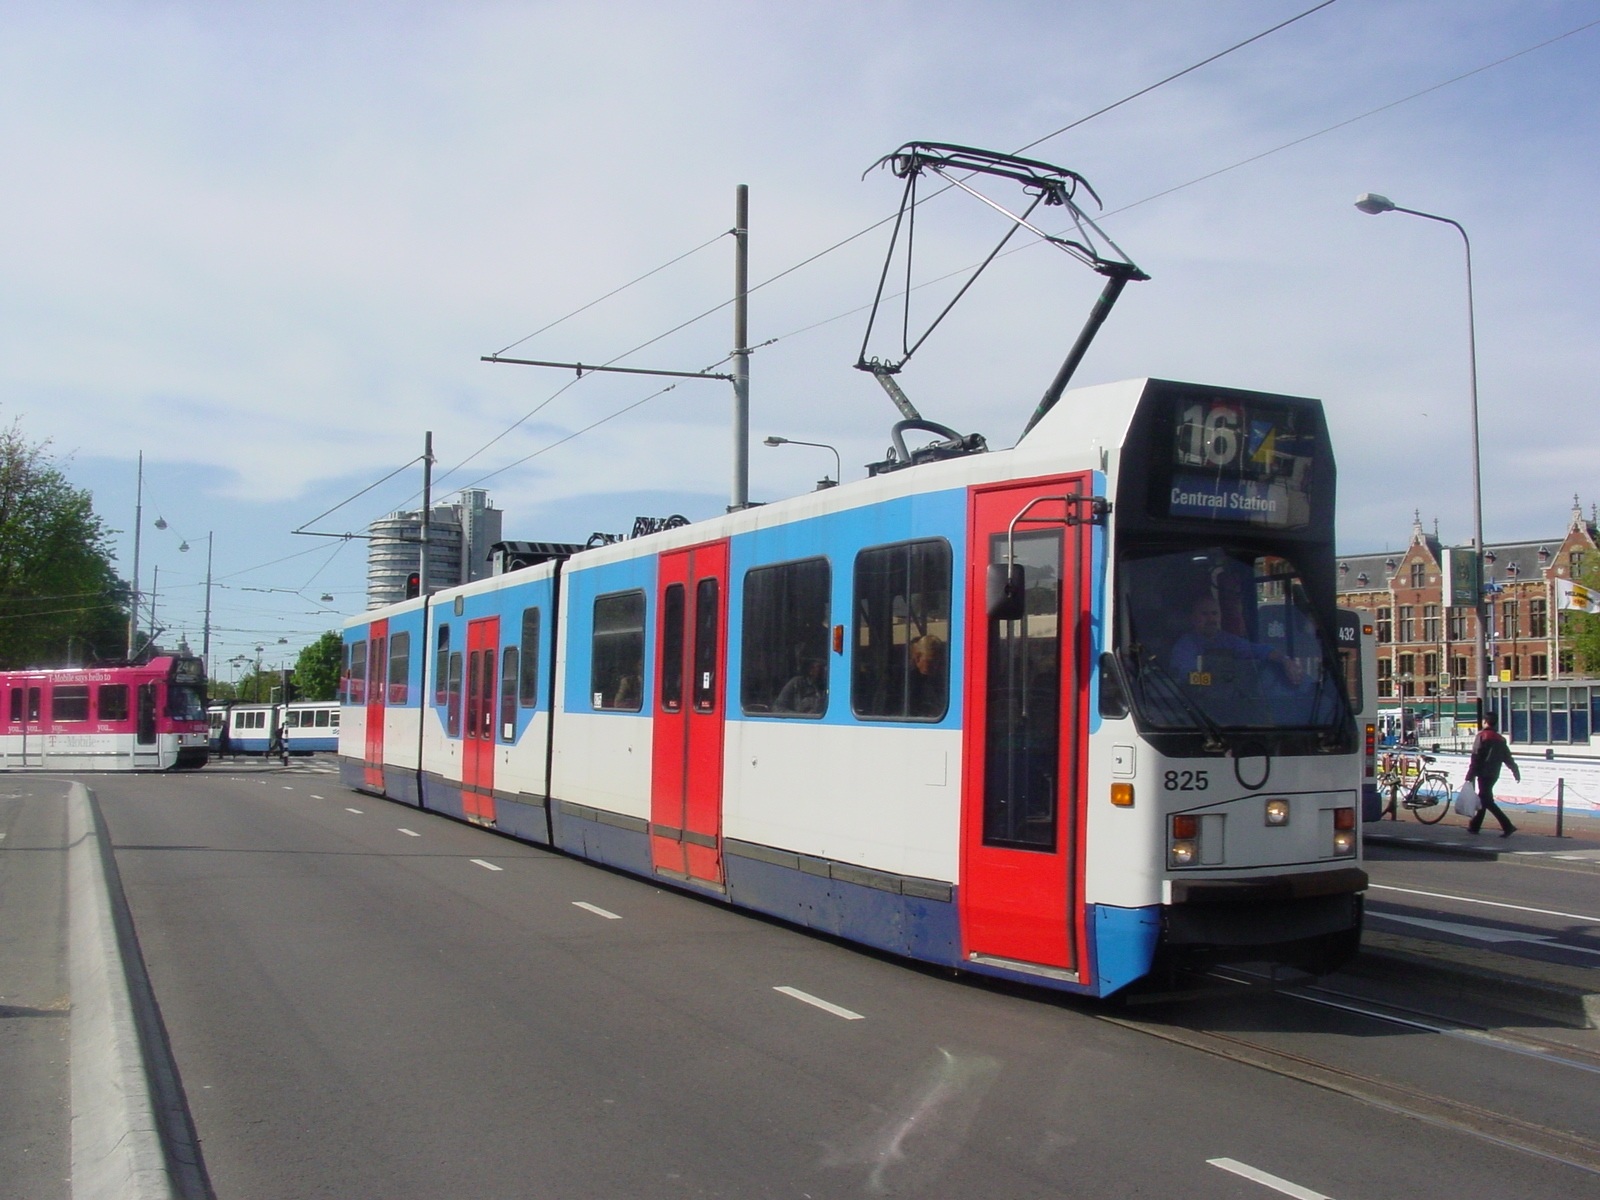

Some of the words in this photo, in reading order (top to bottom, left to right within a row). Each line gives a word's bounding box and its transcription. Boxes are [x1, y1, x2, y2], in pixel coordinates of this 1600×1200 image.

[1183, 404, 1237, 465] 16
[1171, 487, 1227, 508] Centraal
[1230, 492, 1277, 512] Station
[1338, 627, 1355, 641] 432
[48, 674, 74, 682] T-Mobile
[75, 675, 88, 683] says
[88, 673, 103, 681] hello
[1164, 770, 1209, 791] 825
